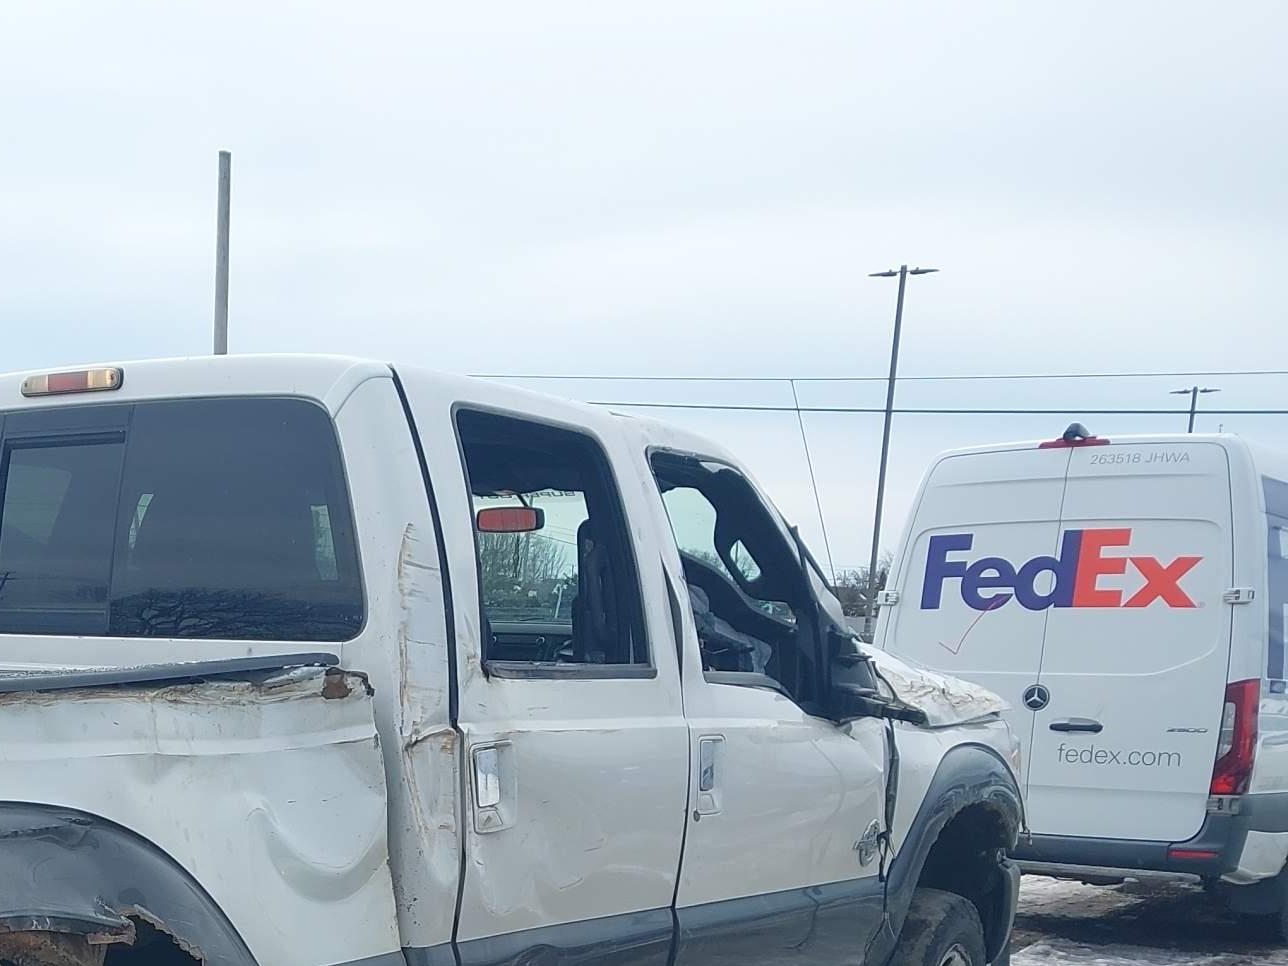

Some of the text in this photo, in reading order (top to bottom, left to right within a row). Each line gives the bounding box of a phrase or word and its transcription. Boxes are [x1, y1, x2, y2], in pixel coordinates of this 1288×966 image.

[1090, 451, 1190, 465] 263518 JHWA
[919, 527, 1205, 611] FedEx
[1057, 743, 1182, 767] fedex.com
